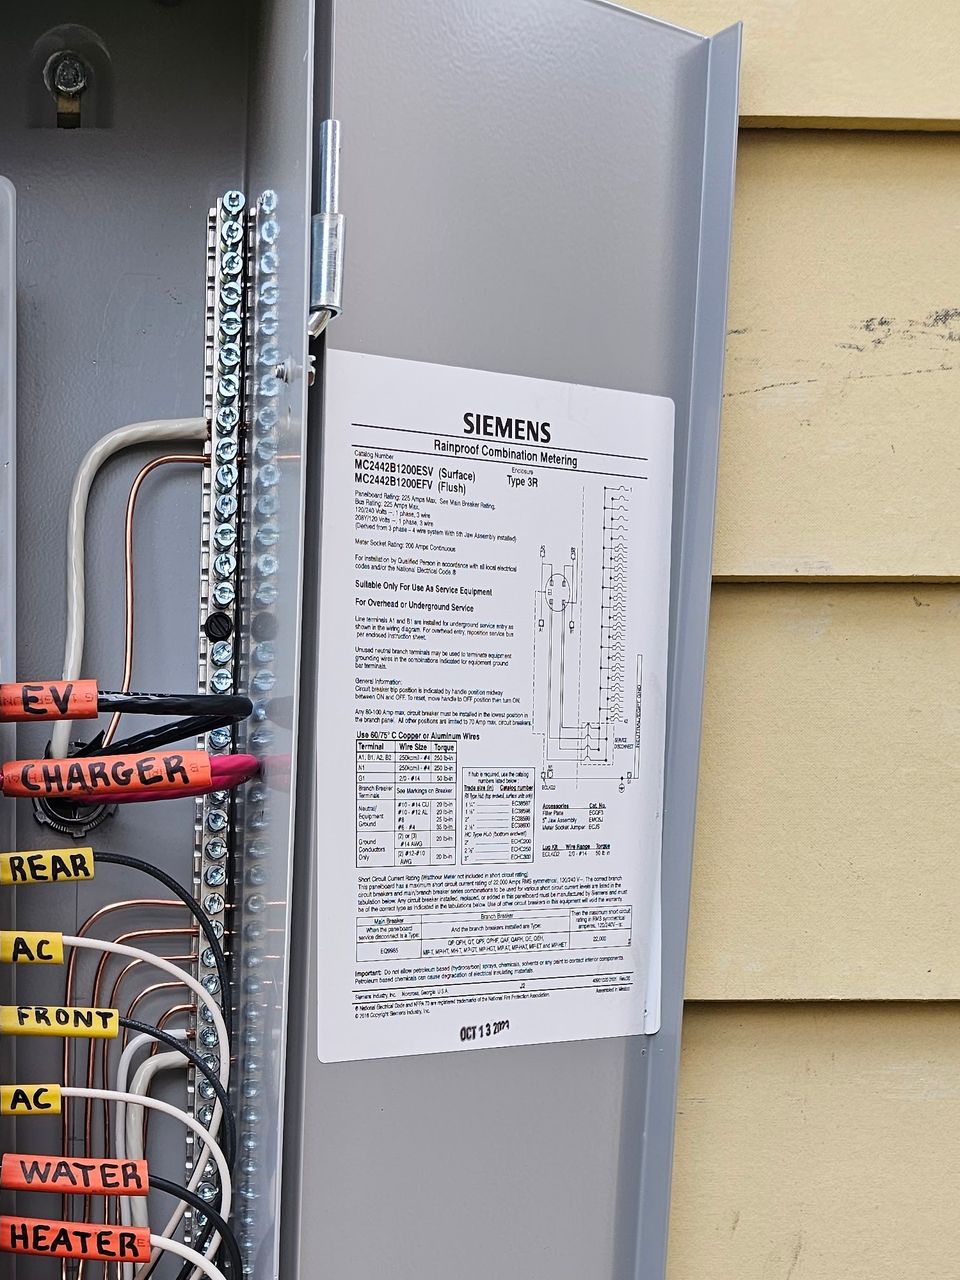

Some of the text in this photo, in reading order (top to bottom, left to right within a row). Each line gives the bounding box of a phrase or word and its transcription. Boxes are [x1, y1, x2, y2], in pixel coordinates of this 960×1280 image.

[463, 412, 551, 443] SIEMENS
[354, 450, 394, 460] Catalog Number
[434, 439, 578, 468] Rainproof Combination Metering
[354, 459, 476, 483] MC2442B1200ESV (Surface)
[507, 475, 538, 488] Type 3R
[511, 467, 534, 475] Enclosure
[354, 473, 466, 496] MC2442B1200EFV (Flush)
[355, 580, 493, 597] Suitable Only For Use As Service Equipment
[355, 597, 366, 606] For
[367, 598, 399, 609] Overhead
[408, 600, 450, 612] Underground
[451, 603, 475, 613] Service
[21, 683, 74, 716] EV
[356, 731, 369, 739] Use
[370, 730, 390, 740] 60/75°
[398, 732, 421, 741] Copper
[430, 731, 462, 741] Aluminum
[462, 732, 480, 741] Wires
[358, 742, 455, 753] Terminal Wire Size Torque
[20, 754, 191, 793] CHARGER
[10, 853, 93, 883] REAR
[11, 937, 54, 962] AC
[354, 970, 382, 978] Important:
[17, 1006, 115, 1029] FRONT
[460, 1026, 477, 1041] OCT
[10, 1088, 52, 1110] AC
[19, 1159, 144, 1189] WATER
[10, 1223, 139, 1257] HEATER
